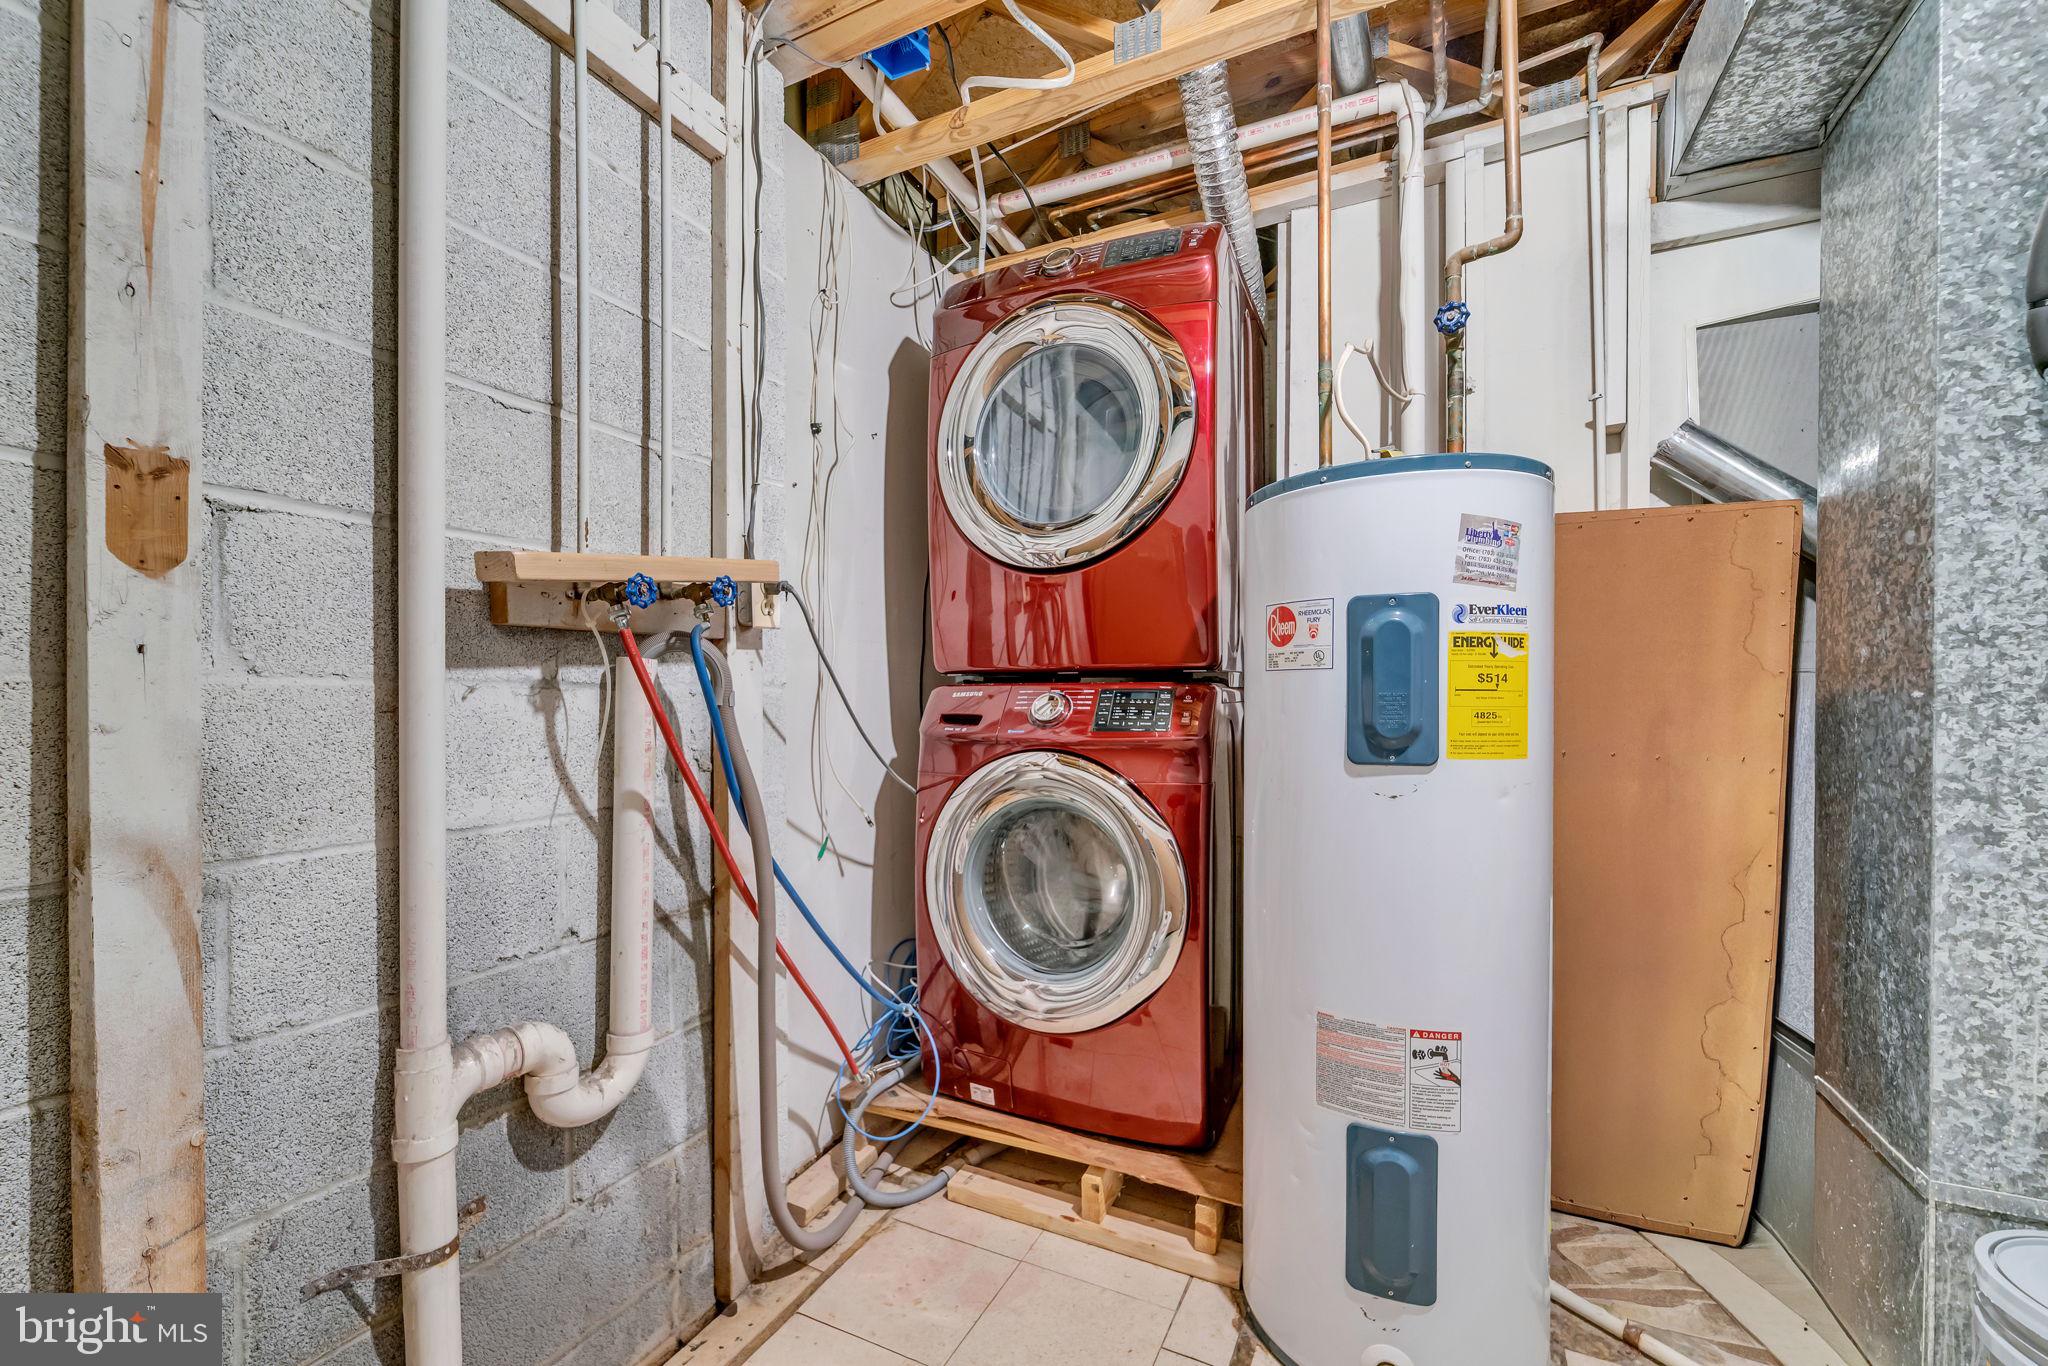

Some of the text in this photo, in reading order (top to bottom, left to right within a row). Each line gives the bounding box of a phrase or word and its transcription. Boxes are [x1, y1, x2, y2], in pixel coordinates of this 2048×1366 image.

[1465, 527, 1492, 538] Liberty
[1469, 604, 1527, 616] EverKleen
[1270, 608, 1296, 642] Rheem
[1477, 673, 1508, 684] $514
[1473, 711, 1498, 719] 4825
[1422, 1032, 1459, 1040] DANGER
